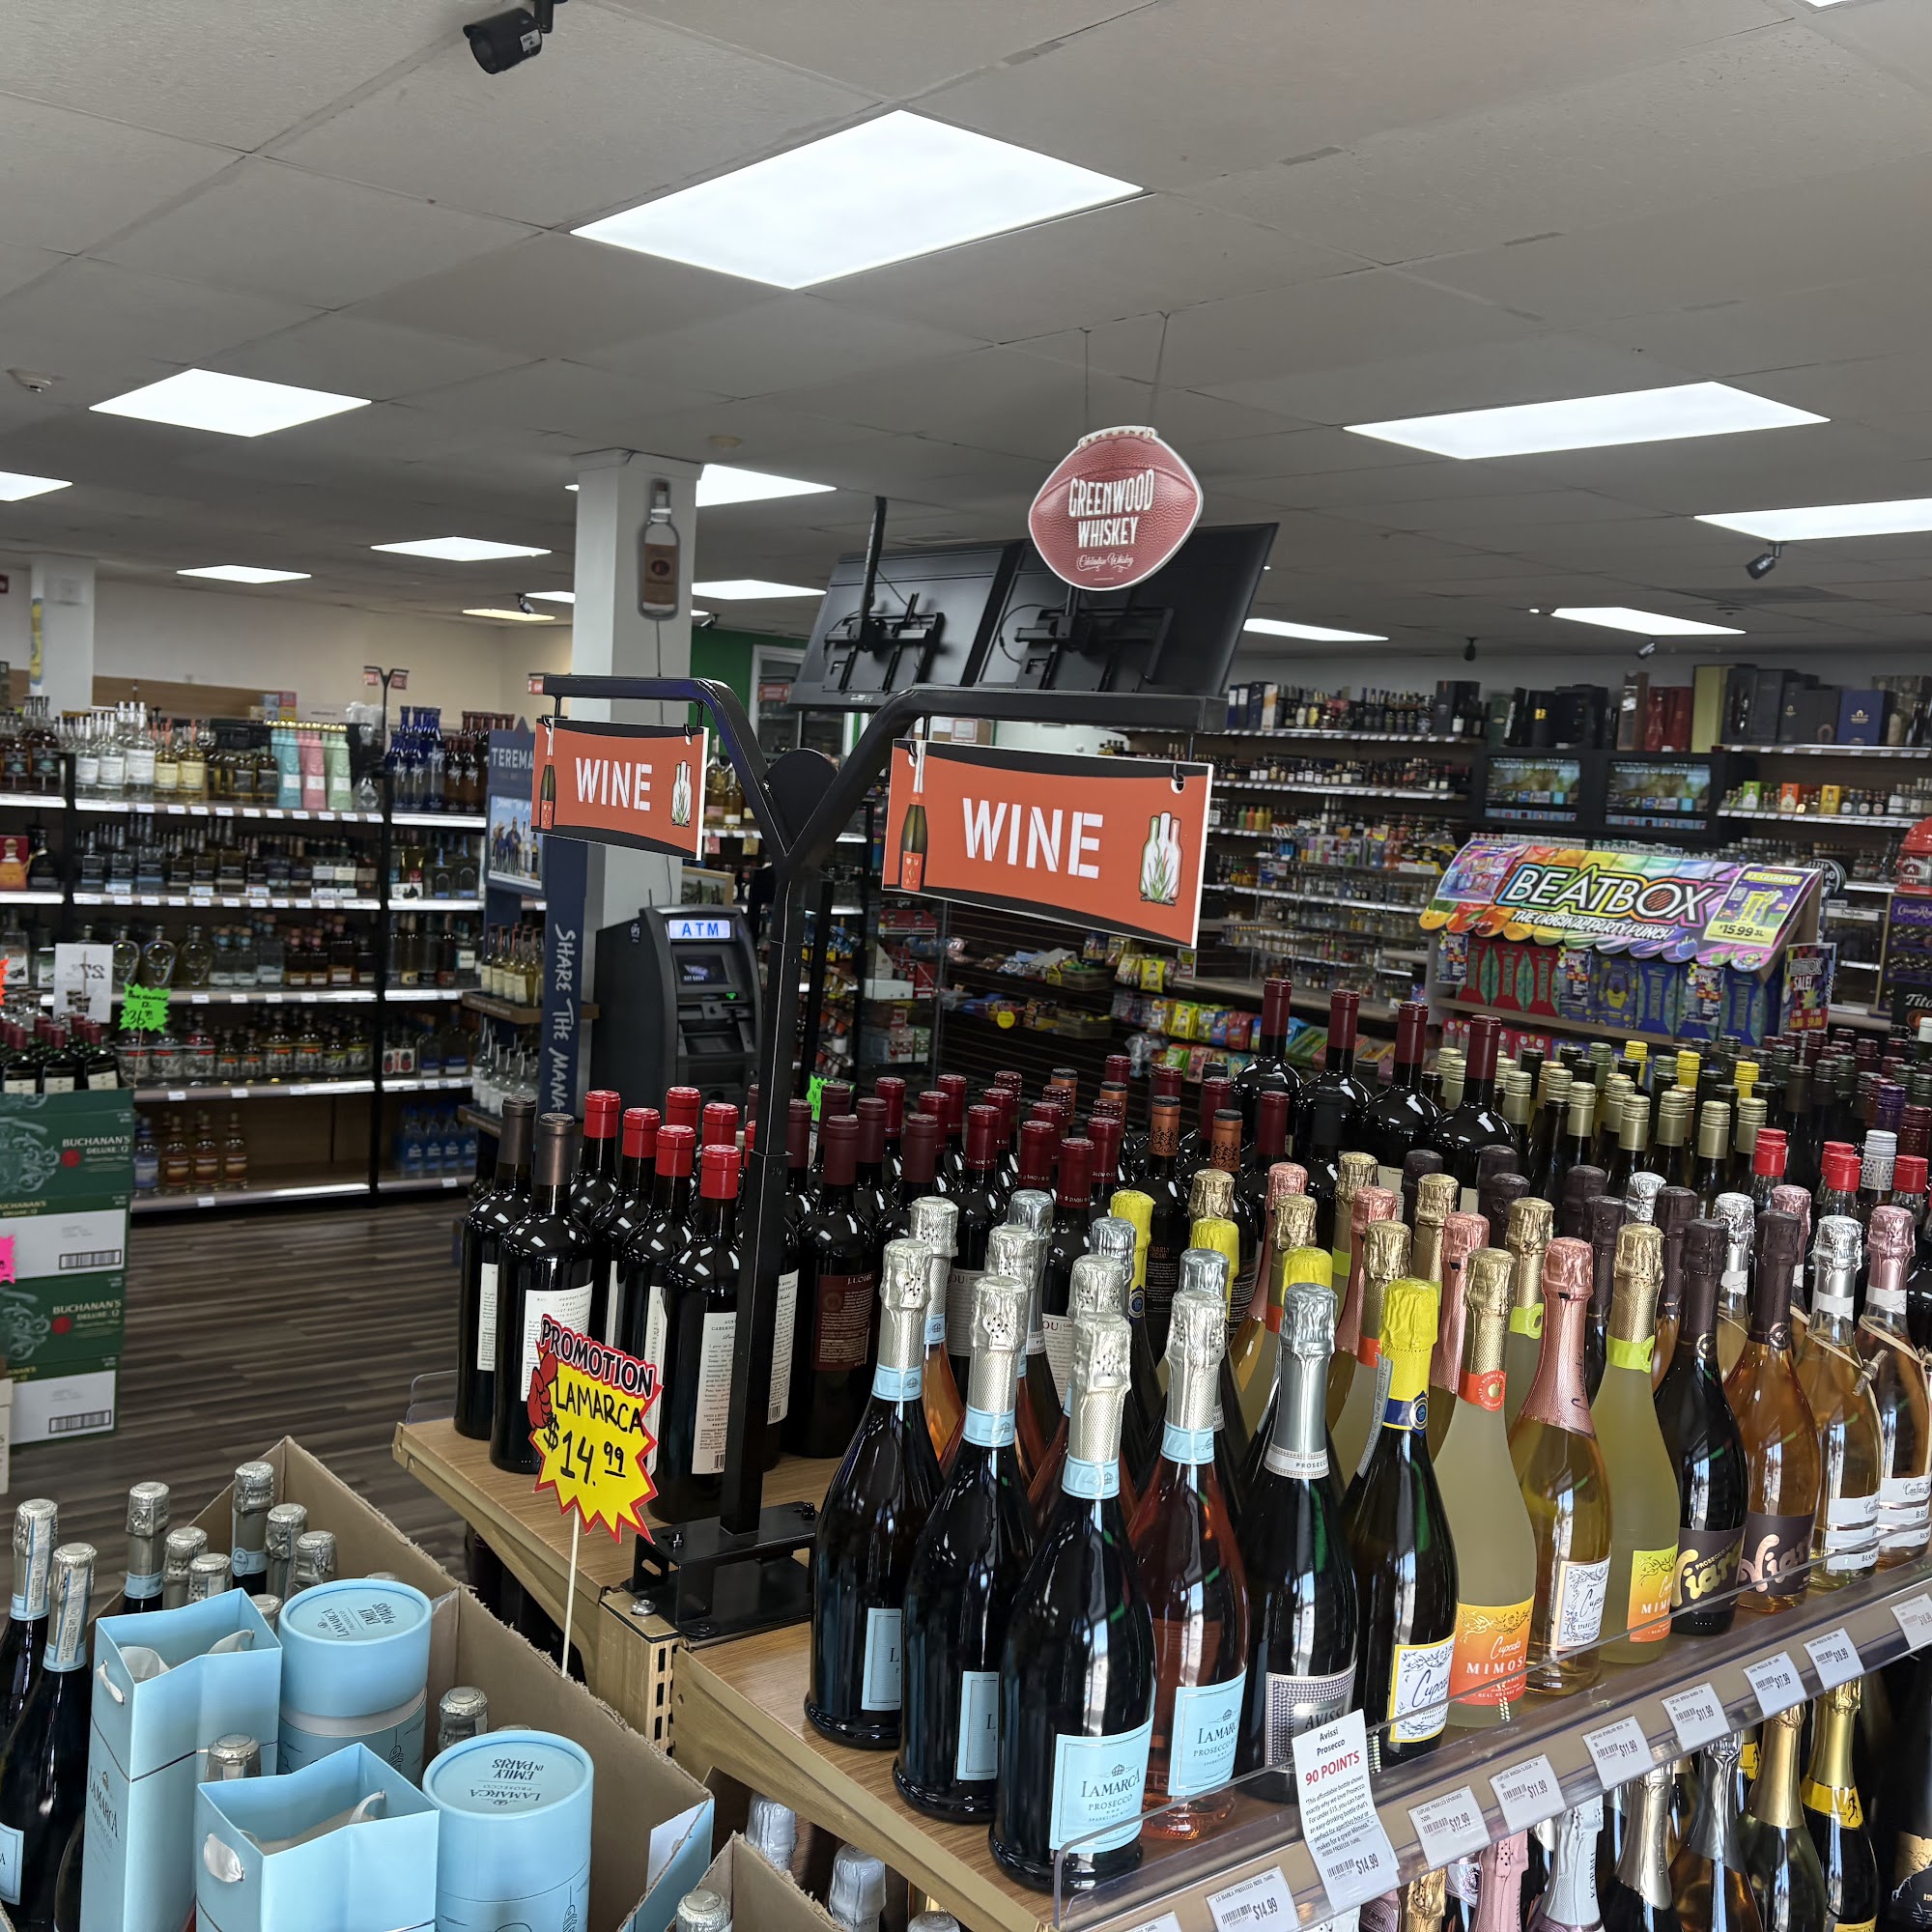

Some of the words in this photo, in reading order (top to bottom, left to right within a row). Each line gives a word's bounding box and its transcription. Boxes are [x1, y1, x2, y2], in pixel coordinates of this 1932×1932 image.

[1068, 469, 1155, 518] GREENWOOD
[1077, 516, 1139, 548] WHISKEY
[574, 756, 653, 811] WINE
[962, 797, 1103, 880] WINE
[1504, 867, 1715, 922] BEATBOX
[681, 922, 719, 938] ATM
[1511, 910, 1534, 924] THE
[1534, 912, 1590, 931] ORIGINAL
[1587, 919, 1628, 935] PARTY
[1627, 924, 1674, 941] PUNCH
[555, 922, 577, 993] SHARE
[552, 997, 575, 1042] THE
[62, 1135, 131, 1148] BUCHANAN'S
[86, 1147, 116, 1155] DELUXE
[52, 1298, 122, 1314] BUCHANAN'S
[539, 1319, 654, 1397] PROMOTION
[555, 1376, 645, 1436] LAMARCA
[321, 1608, 351, 1638] LAMARCA
[356, 1608, 382, 1626] EMILY
[372, 1602, 397, 1624] PARIS
[1695, 1704, 1715, 1721] $11.99
[1320, 1726, 1339, 1742] Avissi
[1193, 1741, 1232, 1757] PROSECCO
[1317, 1739, 1346, 1756] Prosecco
[1618, 1739, 1638, 1758] $11.99
[492, 1758, 536, 1772] PARIS
[493, 1768, 535, 1781] EMILY
[1305, 1769, 1319, 1786] 90
[1321, 1749, 1360, 1779] POINTS
[483, 1783, 533, 1792] PROSECCO
[1080, 1767, 1142, 1799] LAMARCA
[1527, 1779, 1548, 1800] $11.99
[89, 1764, 118, 1838] LAMARCA
[469, 1788, 542, 1803] LAMARCA
[1088, 1793, 1134, 1812] PROSECCO
[1306, 1804, 1321, 1816] exactly
[1337, 1792, 1347, 1801] love
[1317, 1810, 1329, 1822] under
[1338, 1803, 1348, 1812] you
[1354, 1793, 1366, 1803] have
[1449, 1812, 1471, 1833] $12.99
[1355, 1853, 1379, 1876] $14.99
[1252, 1896, 1278, 1921] $14.99
